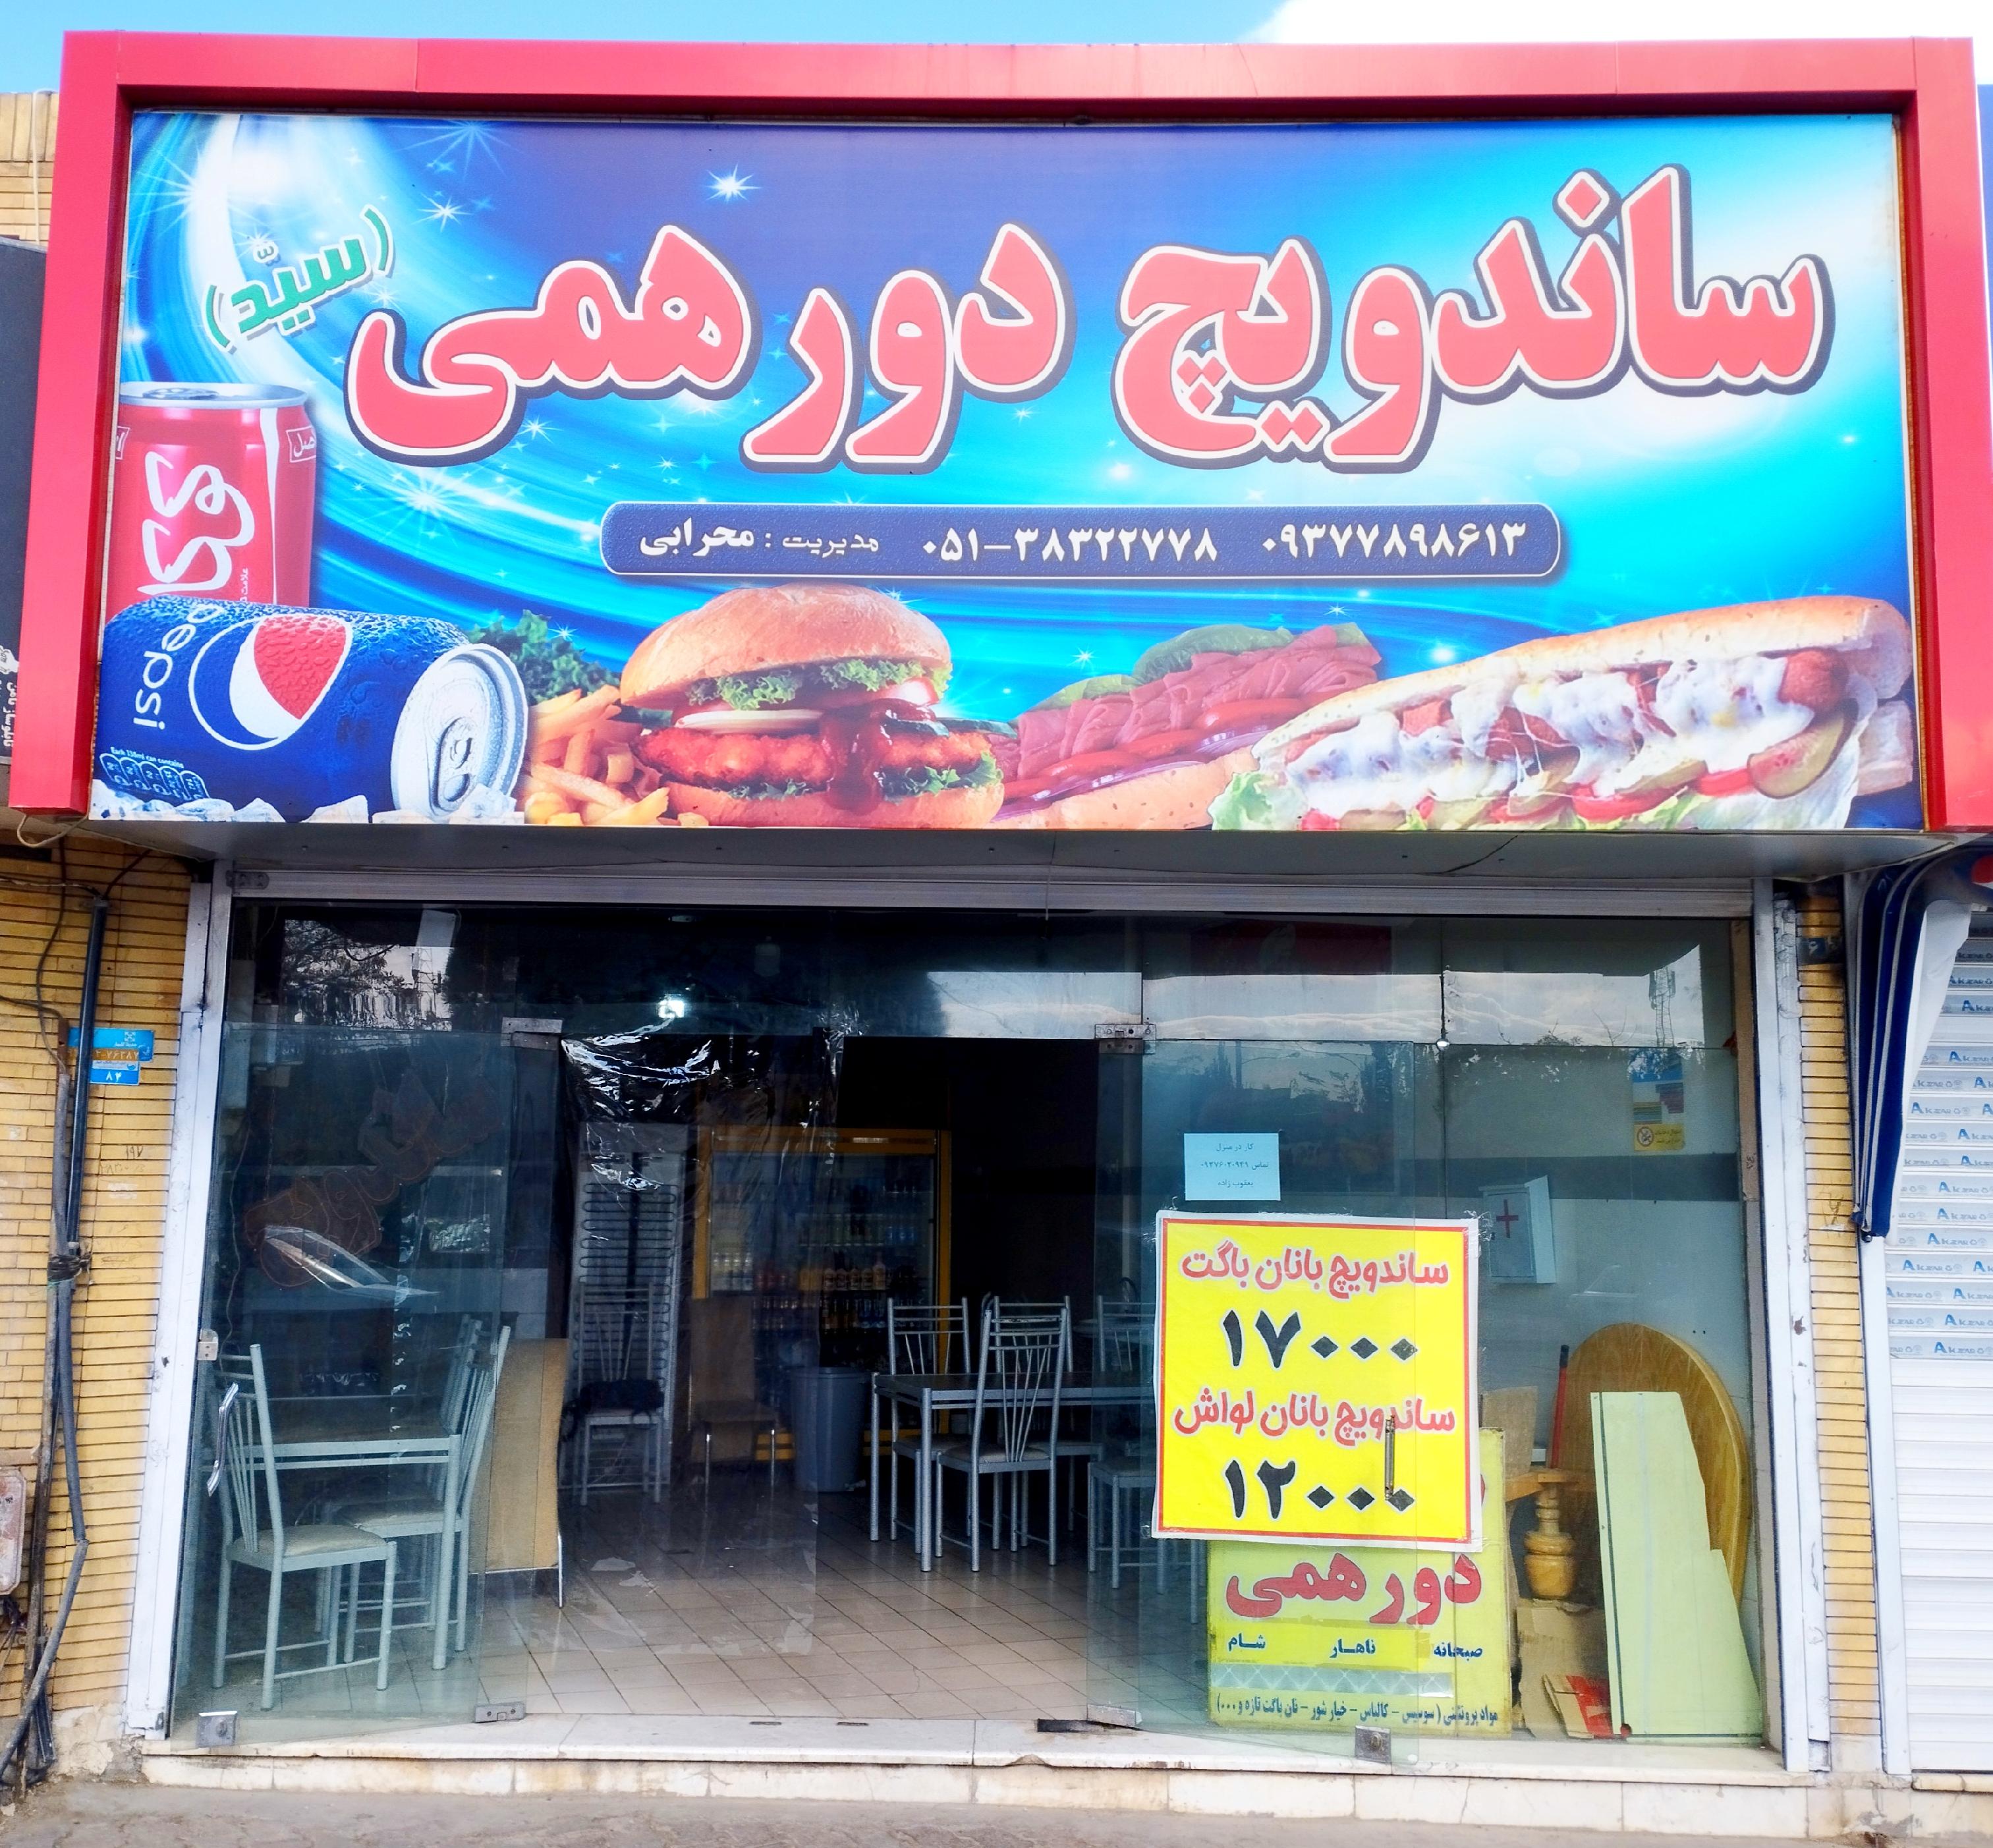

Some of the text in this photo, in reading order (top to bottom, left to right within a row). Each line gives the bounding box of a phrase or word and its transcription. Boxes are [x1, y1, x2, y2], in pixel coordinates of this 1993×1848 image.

[1115, 167, 1824, 462] ساندویچ
[640, 517, 754, 557] محرابی
[1262, 522, 1526, 558] ۰۹۳۷۷۸۹۸۶۱۳
[1183, 1241, 1249, 1288] باگت
[1329, 1253, 1449, 1299] ساندویچ
[1221, 1309, 1418, 1369] ۱۷۰۰۰
[1174, 1387, 1254, 1435] لواش
[1225, 1459, 1415, 1519] ۱۲۰۰۰
[1227, 1633, 1483, 1658] صبحانه ناهار شام
[1311, 1700, 1327, 1721] شور
[1330, 1700, 1347, 1722] خیار
[1360, 1702, 1389, 1722] کالباس
[1480, 1704, 1498, 1726] مواد
